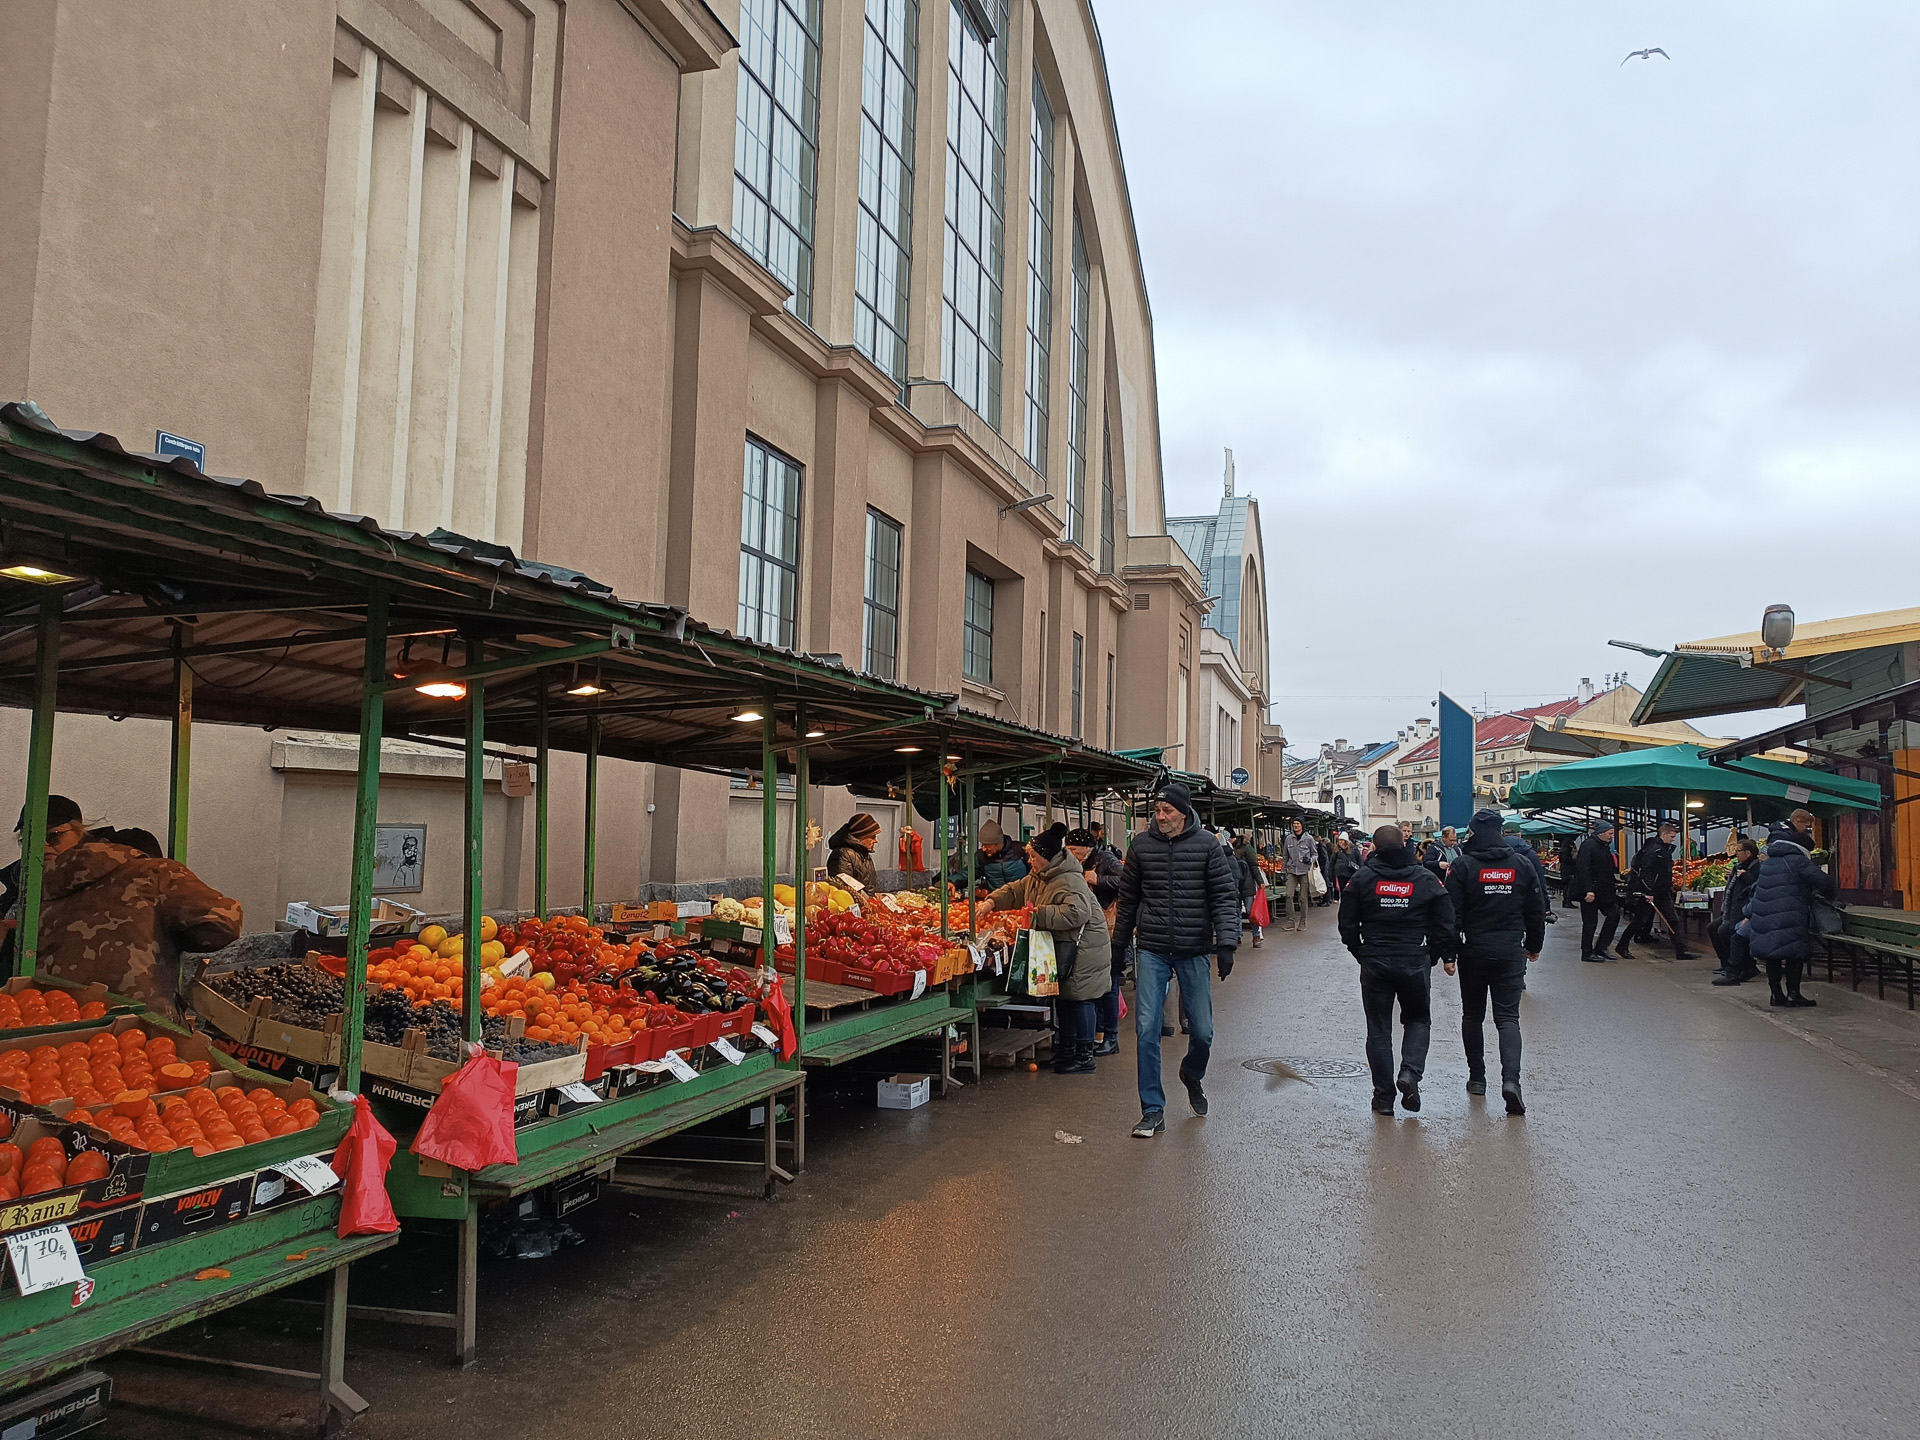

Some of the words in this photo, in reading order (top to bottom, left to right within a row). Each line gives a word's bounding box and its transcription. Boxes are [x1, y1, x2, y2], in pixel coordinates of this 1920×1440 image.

[1482, 871, 1512, 881] rolling!
[1379, 884, 1410, 894] rolling!
[372, 1084, 436, 1109] PREMIUM
[514, 1095, 538, 1112] PREM
[177, 1188, 223, 1212] ALTURA
[563, 1193, 590, 1213] PREMIUM
[9, 1201, 66, 1229] Rana
[70, 1220, 104, 1242] ALTU
